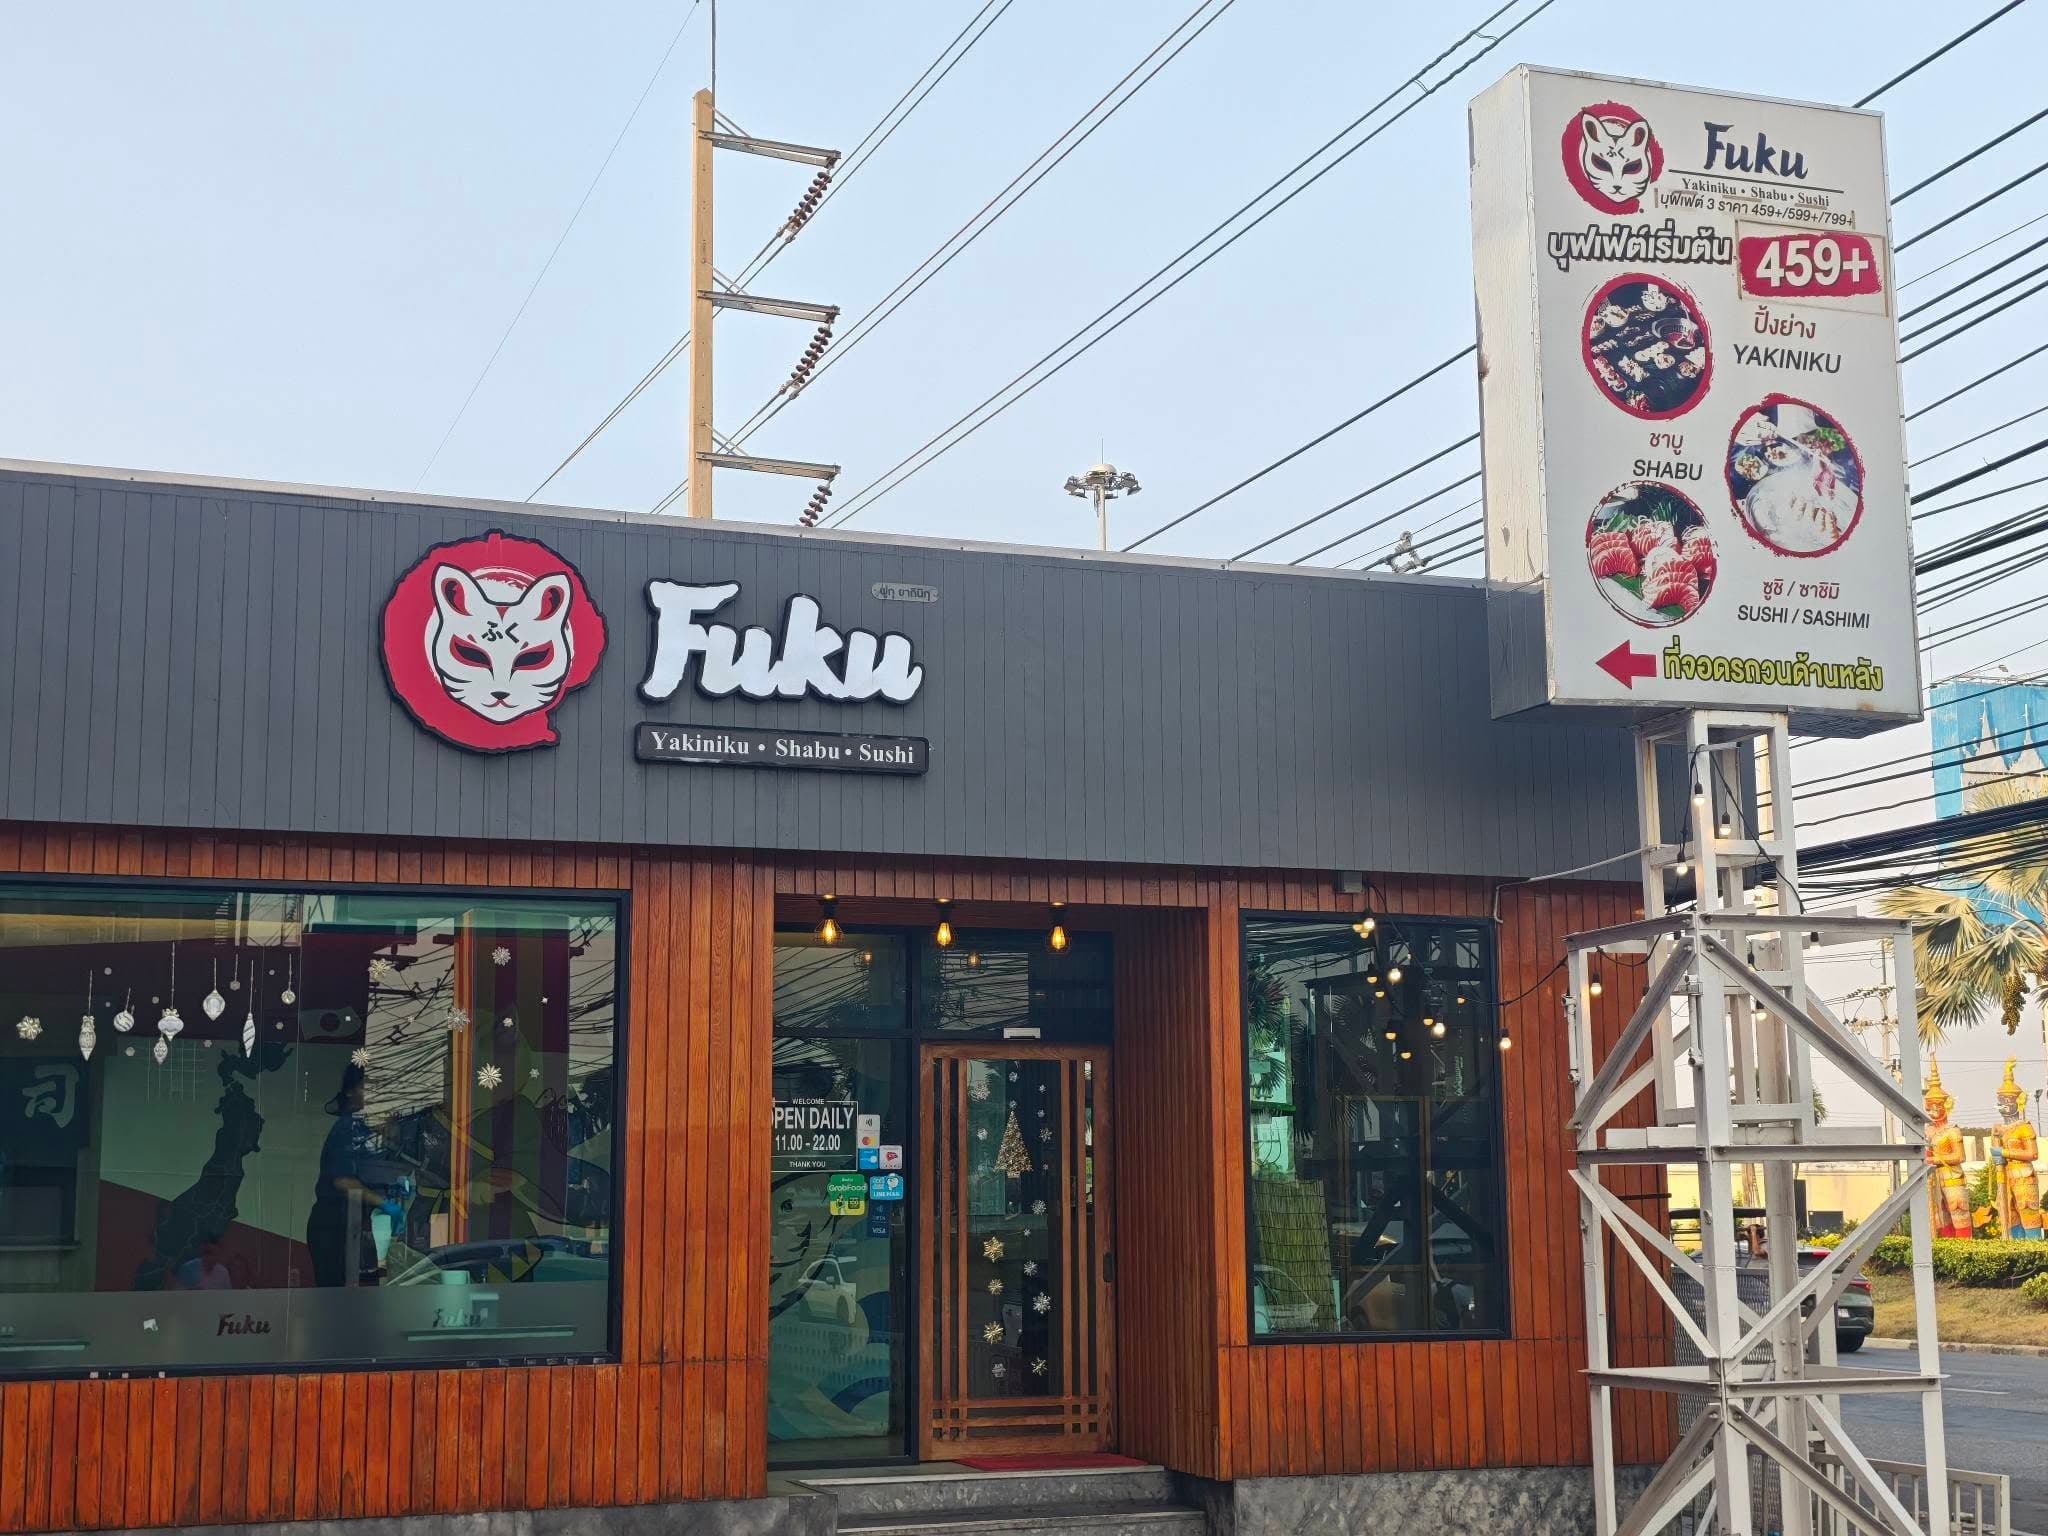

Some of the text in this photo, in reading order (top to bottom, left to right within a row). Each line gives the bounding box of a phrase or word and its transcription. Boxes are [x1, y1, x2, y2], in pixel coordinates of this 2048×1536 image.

[1703, 121, 1809, 180] Fuku
[1682, 177, 1830, 207] Yakiniku Shabu Sushi
[1706, 198, 1716, 210] 3
[1717, 201, 1748, 214] ราคา
[1751, 203, 1853, 227] 459+/599+/799+
[1755, 237, 1869, 289] 459+
[1733, 343, 1842, 375] YAKINIKU
[1649, 430, 1684, 456] ชาบู
[1632, 458, 1703, 481] SHABU
[1737, 604, 1789, 624] SUSHI
[1802, 608, 1871, 629] SASHIMI
[481, 620, 520, 644] ふく
[641, 579, 924, 702] Fuku
[1663, 635, 1884, 691] ที่จอดรถวนด้านหลัง
[650, 730, 915, 765] Yakiniku Shabu Sushi
[791, 1098, 825, 1106] WELCOME
[771, 1108, 854, 1129] PEN DAILY
[775, 1134, 803, 1151] 11.00
[812, 1134, 841, 1151] 22.00
[811, 1160, 826, 1168] YOU
[216, 1313, 273, 1336] Fuku
